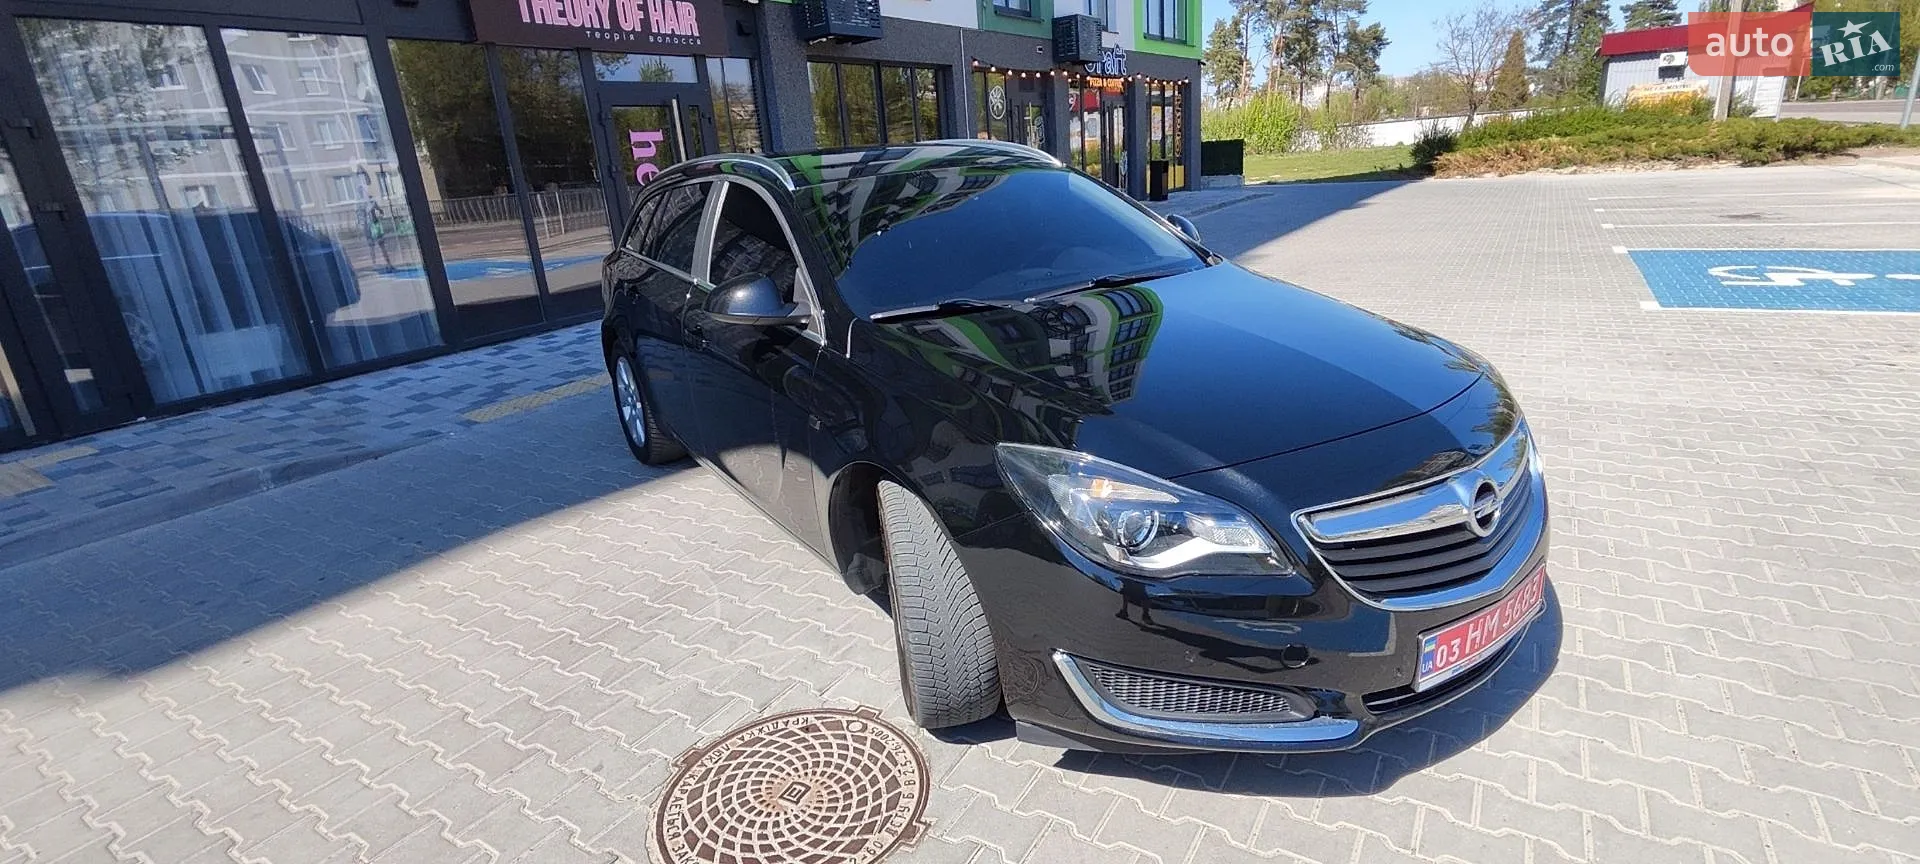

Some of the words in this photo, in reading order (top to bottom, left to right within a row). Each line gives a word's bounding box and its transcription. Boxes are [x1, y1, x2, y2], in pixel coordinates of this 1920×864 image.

[518, 0, 611, 30] THEORY
[615, 0, 645, 32] OF
[647, 0, 700, 37] HAIR
[1422, 661, 1433, 673] UA
[1436, 638, 1462, 668] 03
